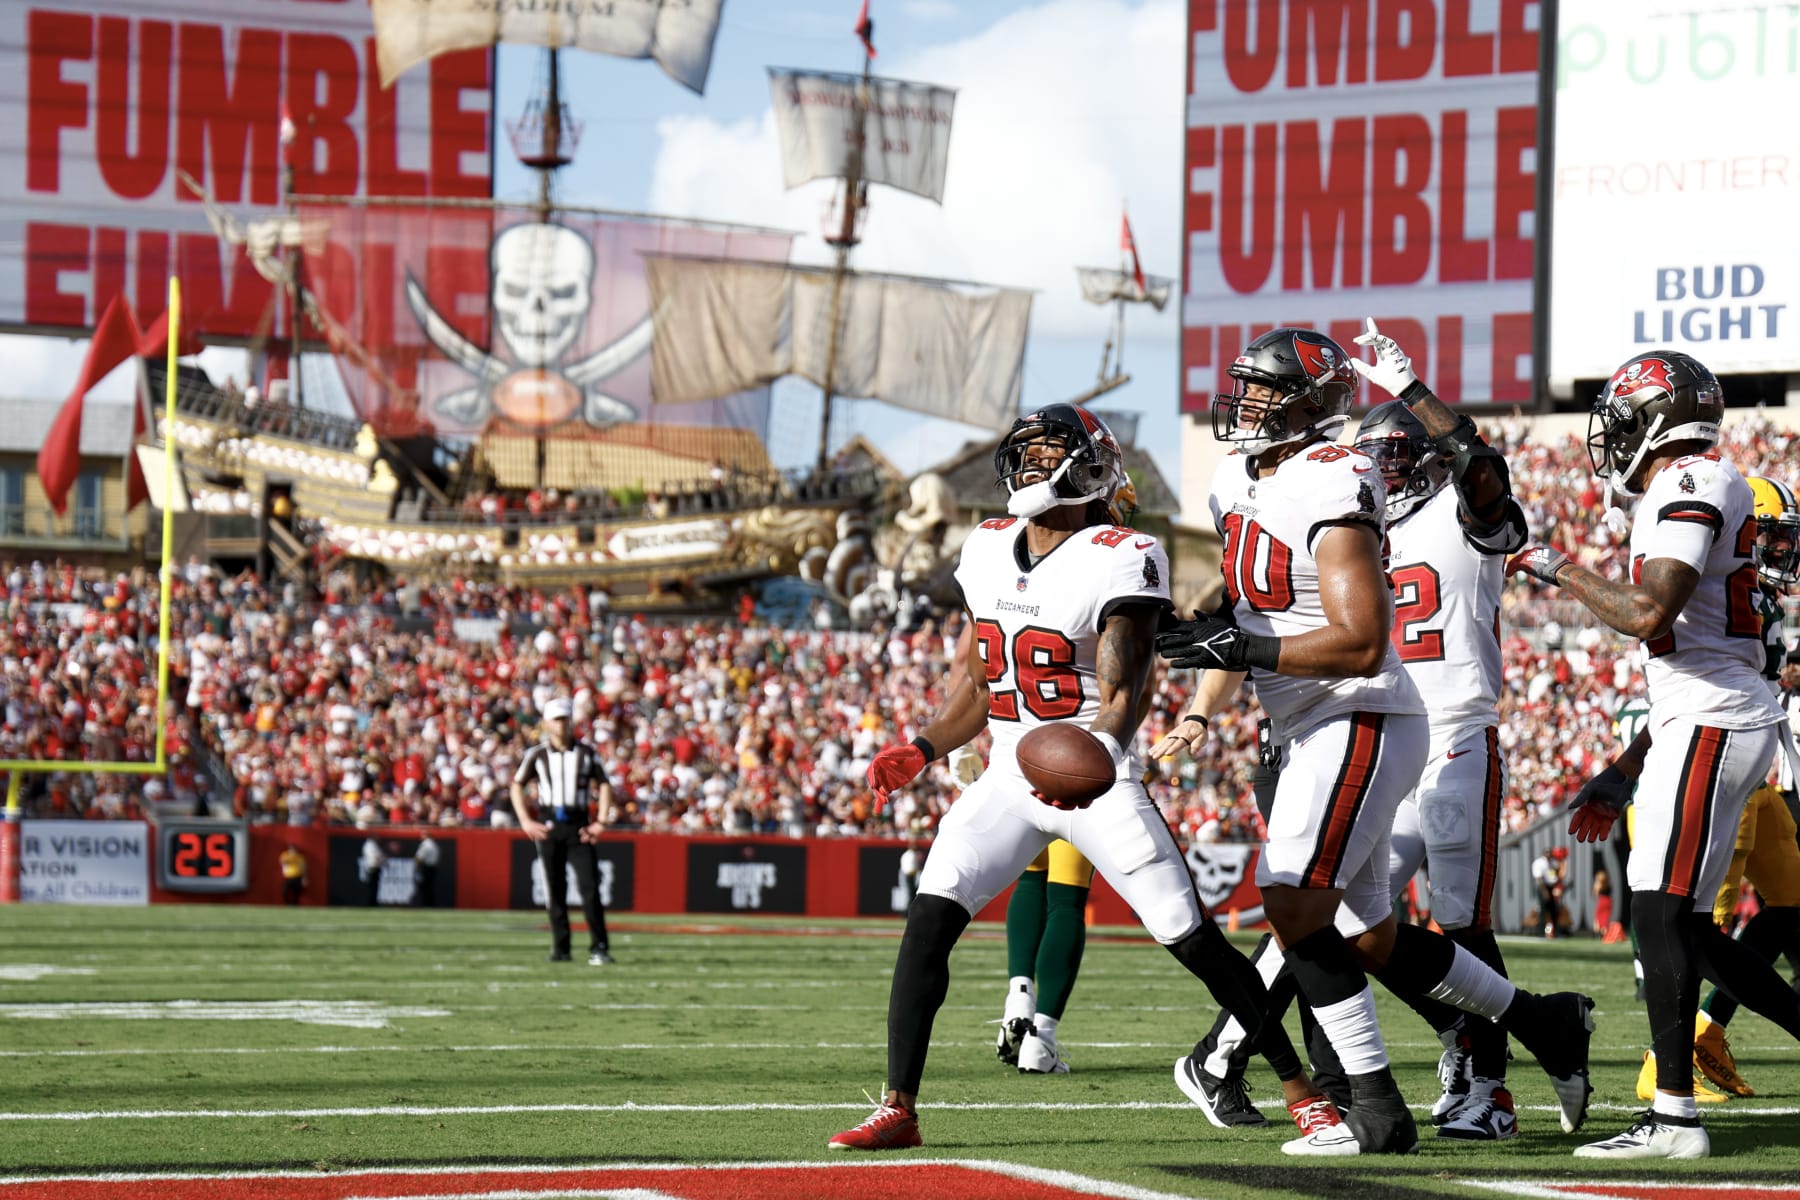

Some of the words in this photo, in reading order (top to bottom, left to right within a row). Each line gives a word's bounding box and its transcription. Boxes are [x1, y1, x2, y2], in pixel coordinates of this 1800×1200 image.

[27, 9, 490, 206] FUMBLE
[1557, 154, 1790, 197] FRONTIER
[1184, 106, 1538, 294] FUMBLE
[1656, 264, 1764, 301] BUD
[1634, 304, 1787, 343] LIGHT
[995, 598, 1040, 616] BUCCANEERS
[976, 617, 1085, 721] 26
[49, 835, 140, 858] VISION
[174, 832, 233, 878] 25
